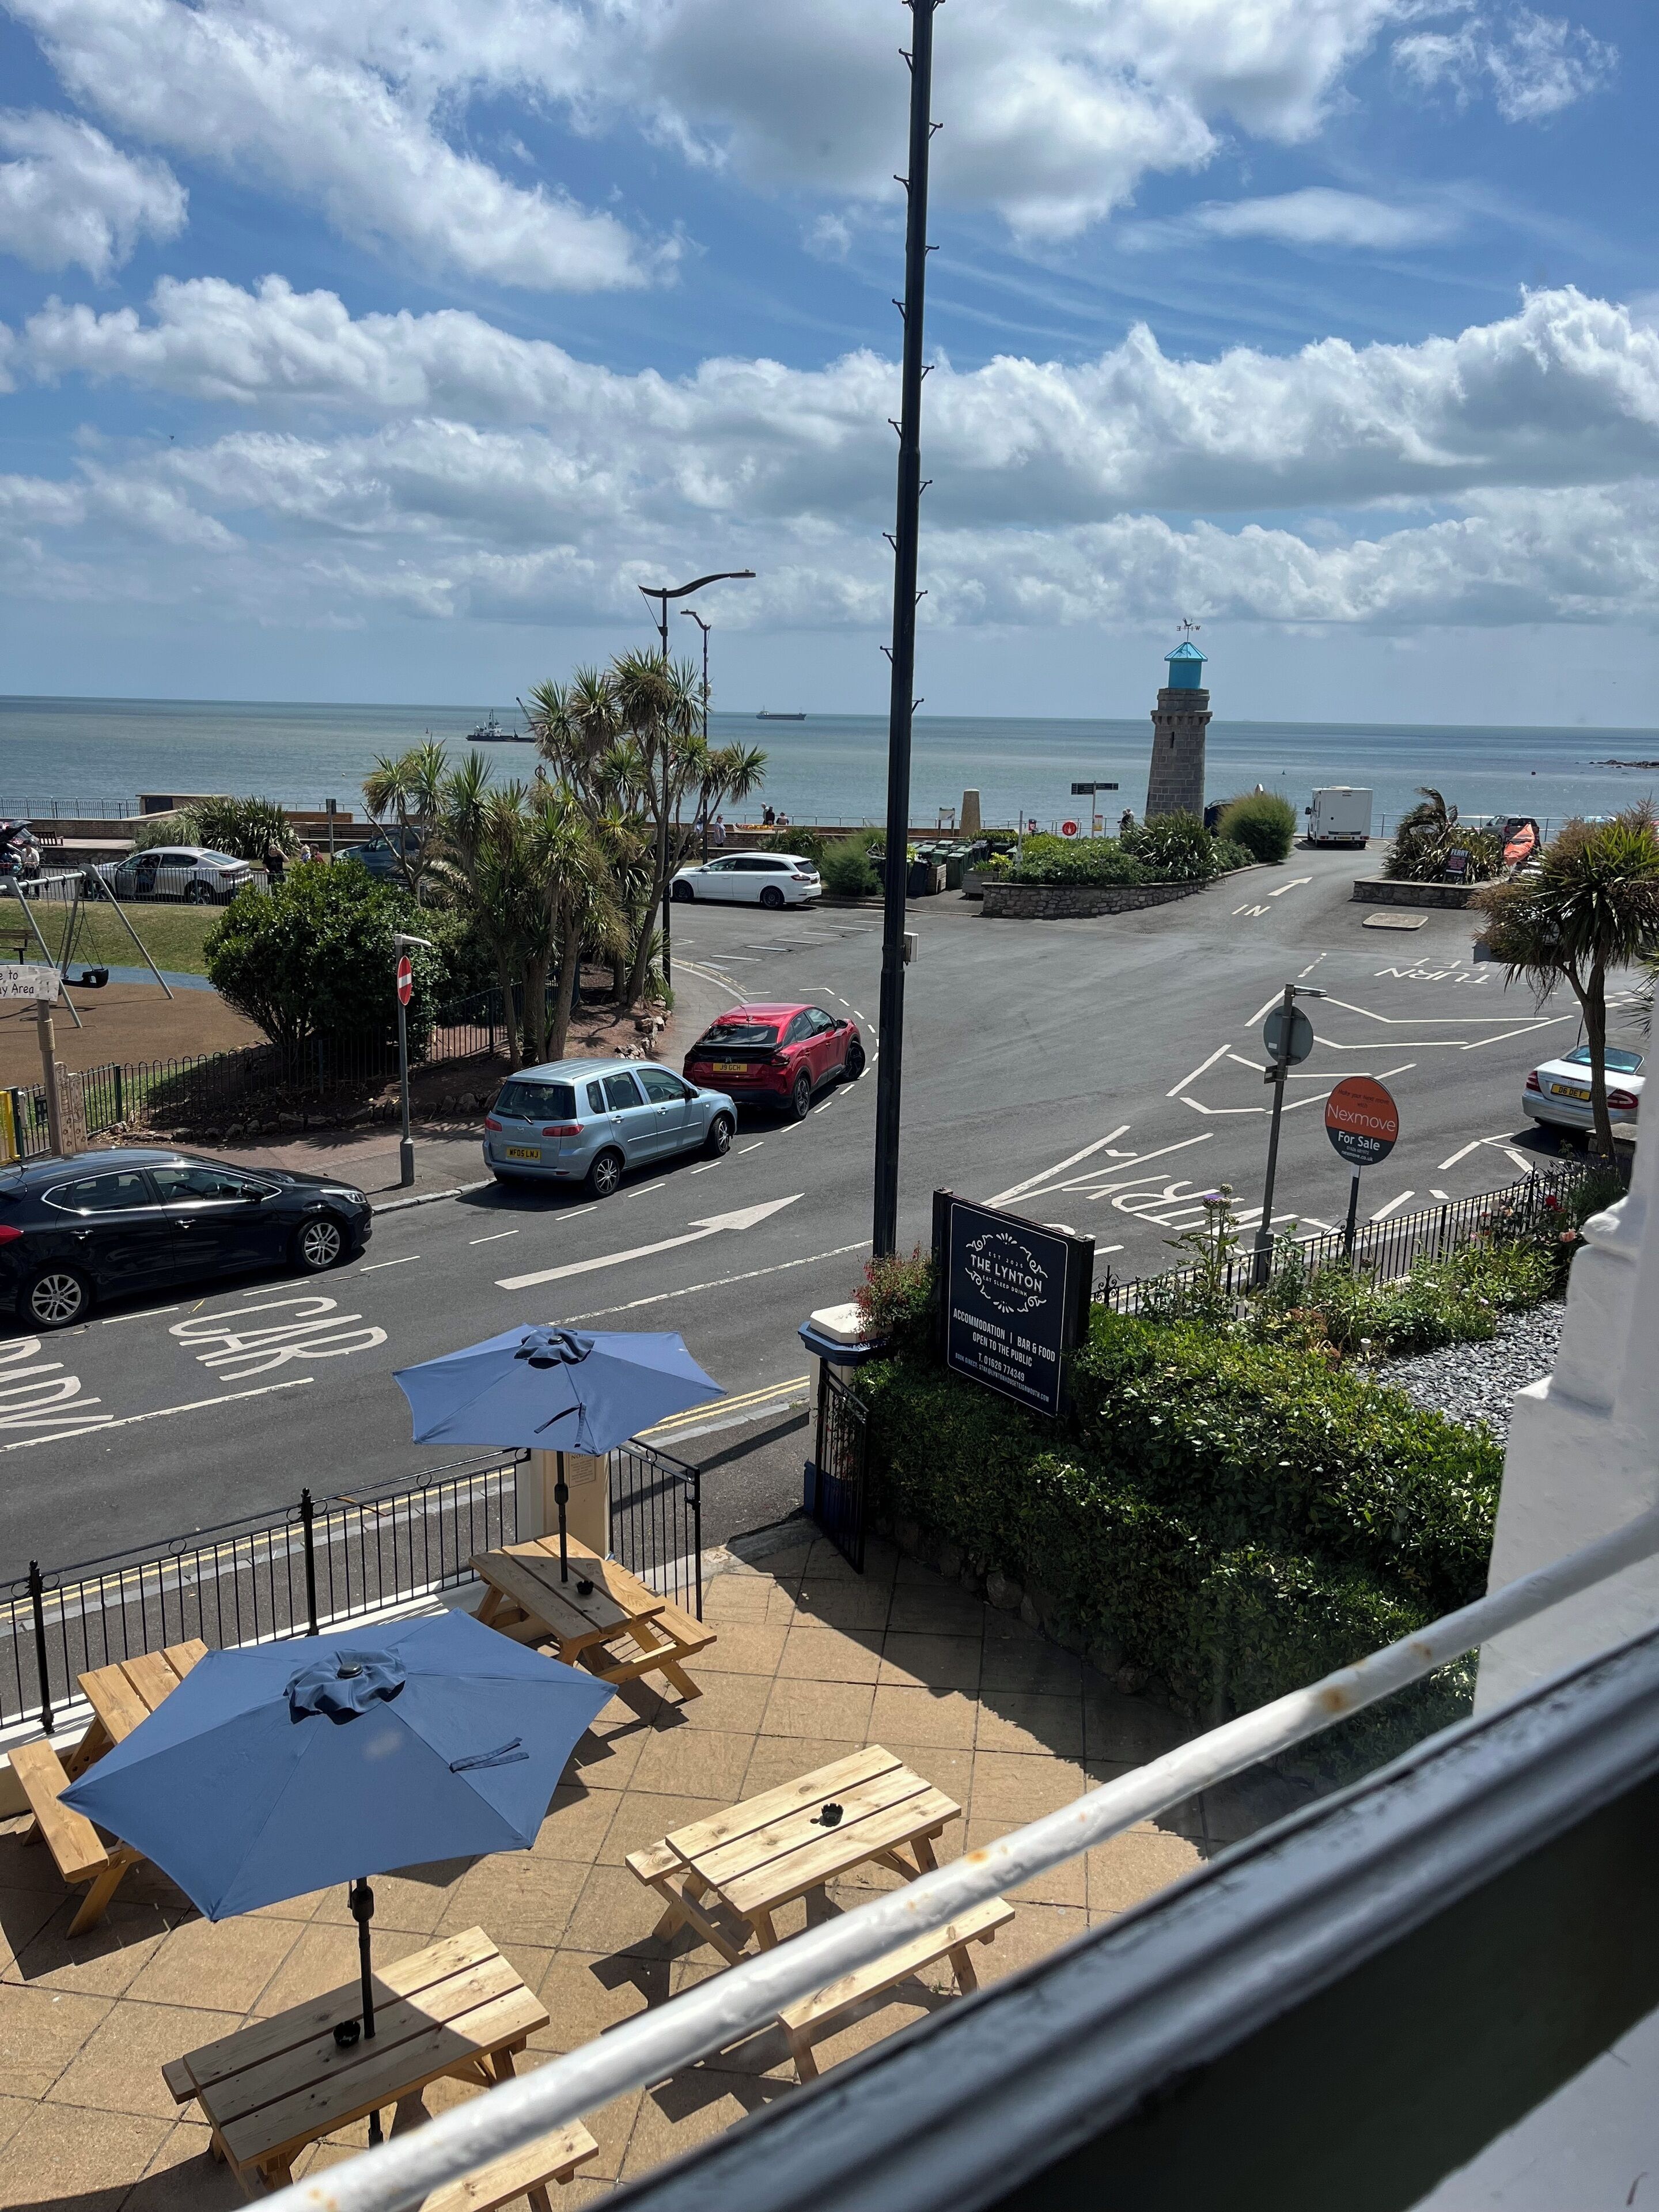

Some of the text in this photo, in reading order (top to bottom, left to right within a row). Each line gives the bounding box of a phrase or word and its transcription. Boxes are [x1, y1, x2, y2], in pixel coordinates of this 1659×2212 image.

[1450, 849, 1469, 857] FERRY
[1231, 904, 1271, 917] IN
[8, 969, 18, 980] to
[1373, 968, 1490, 984] TURN
[12, 983, 34, 994] Area
[1569, 1089, 1584, 1097] DET
[1327, 1104, 1396, 1131] Nexmove
[1338, 1131, 1380, 1151] For Sale
[509, 1149, 525, 1157] WF05
[1342, 1150, 1373, 1162] nexmove.co.uk
[988, 1251, 1001, 1260] EST
[970, 1254, 1042, 1293] THE LYNTON
[983, 1275, 1028, 1297] EAT SLEEP DRINK
[168, 1297, 388, 1381] CAR
[953, 1308, 1005, 1340] ACCOMMODATION
[1017, 1336, 1031, 1351] BAR
[1032, 1343, 1036, 1354] &
[1038, 1345, 1055, 1362] FOOD
[973, 1332, 1032, 1367] OPEN TO THE PUBLIC
[979, 1353, 1024, 1381] T. 01626 774349
